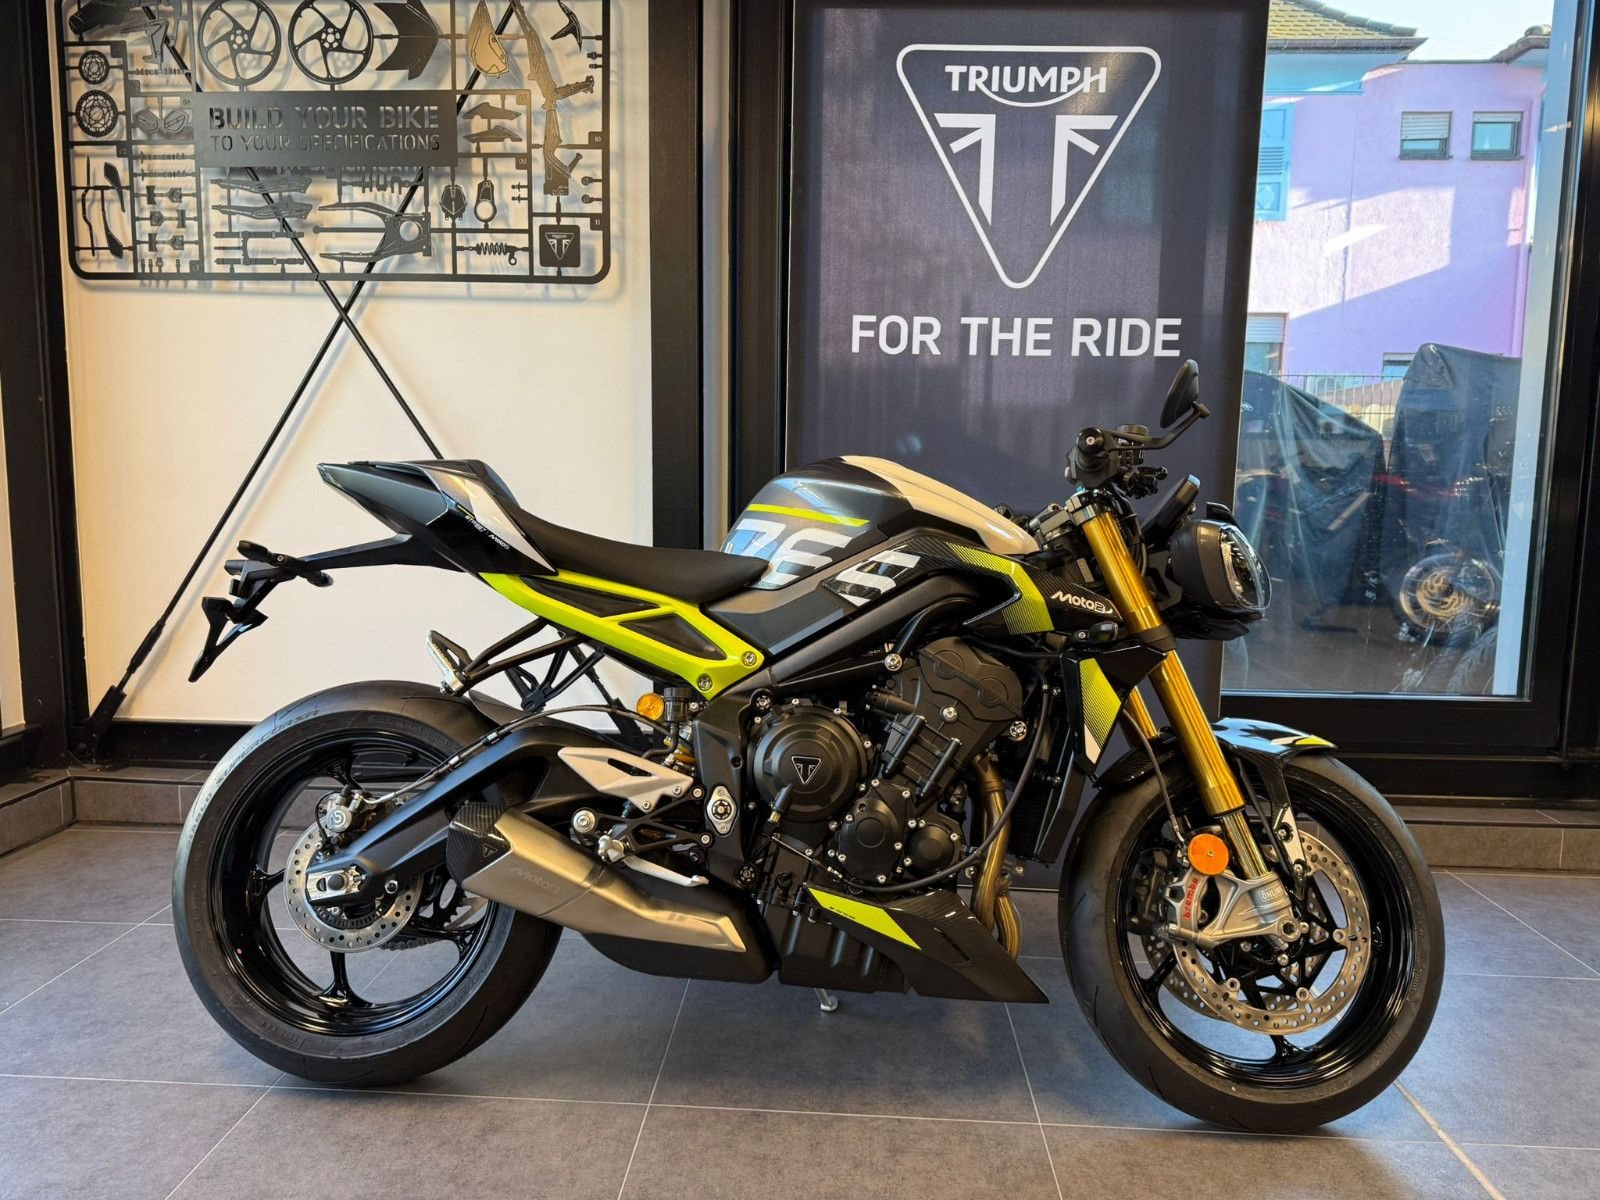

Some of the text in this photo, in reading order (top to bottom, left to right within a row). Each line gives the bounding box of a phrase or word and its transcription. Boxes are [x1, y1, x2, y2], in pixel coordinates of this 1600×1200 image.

[944, 65, 1107, 107] TRIUMPH
[209, 106, 439, 129] BUILD YOUR BIKE
[210, 134, 440, 151] TO YOUR SPECIFICATIONS
[851, 314, 1182, 357] FOR THE RIDE
